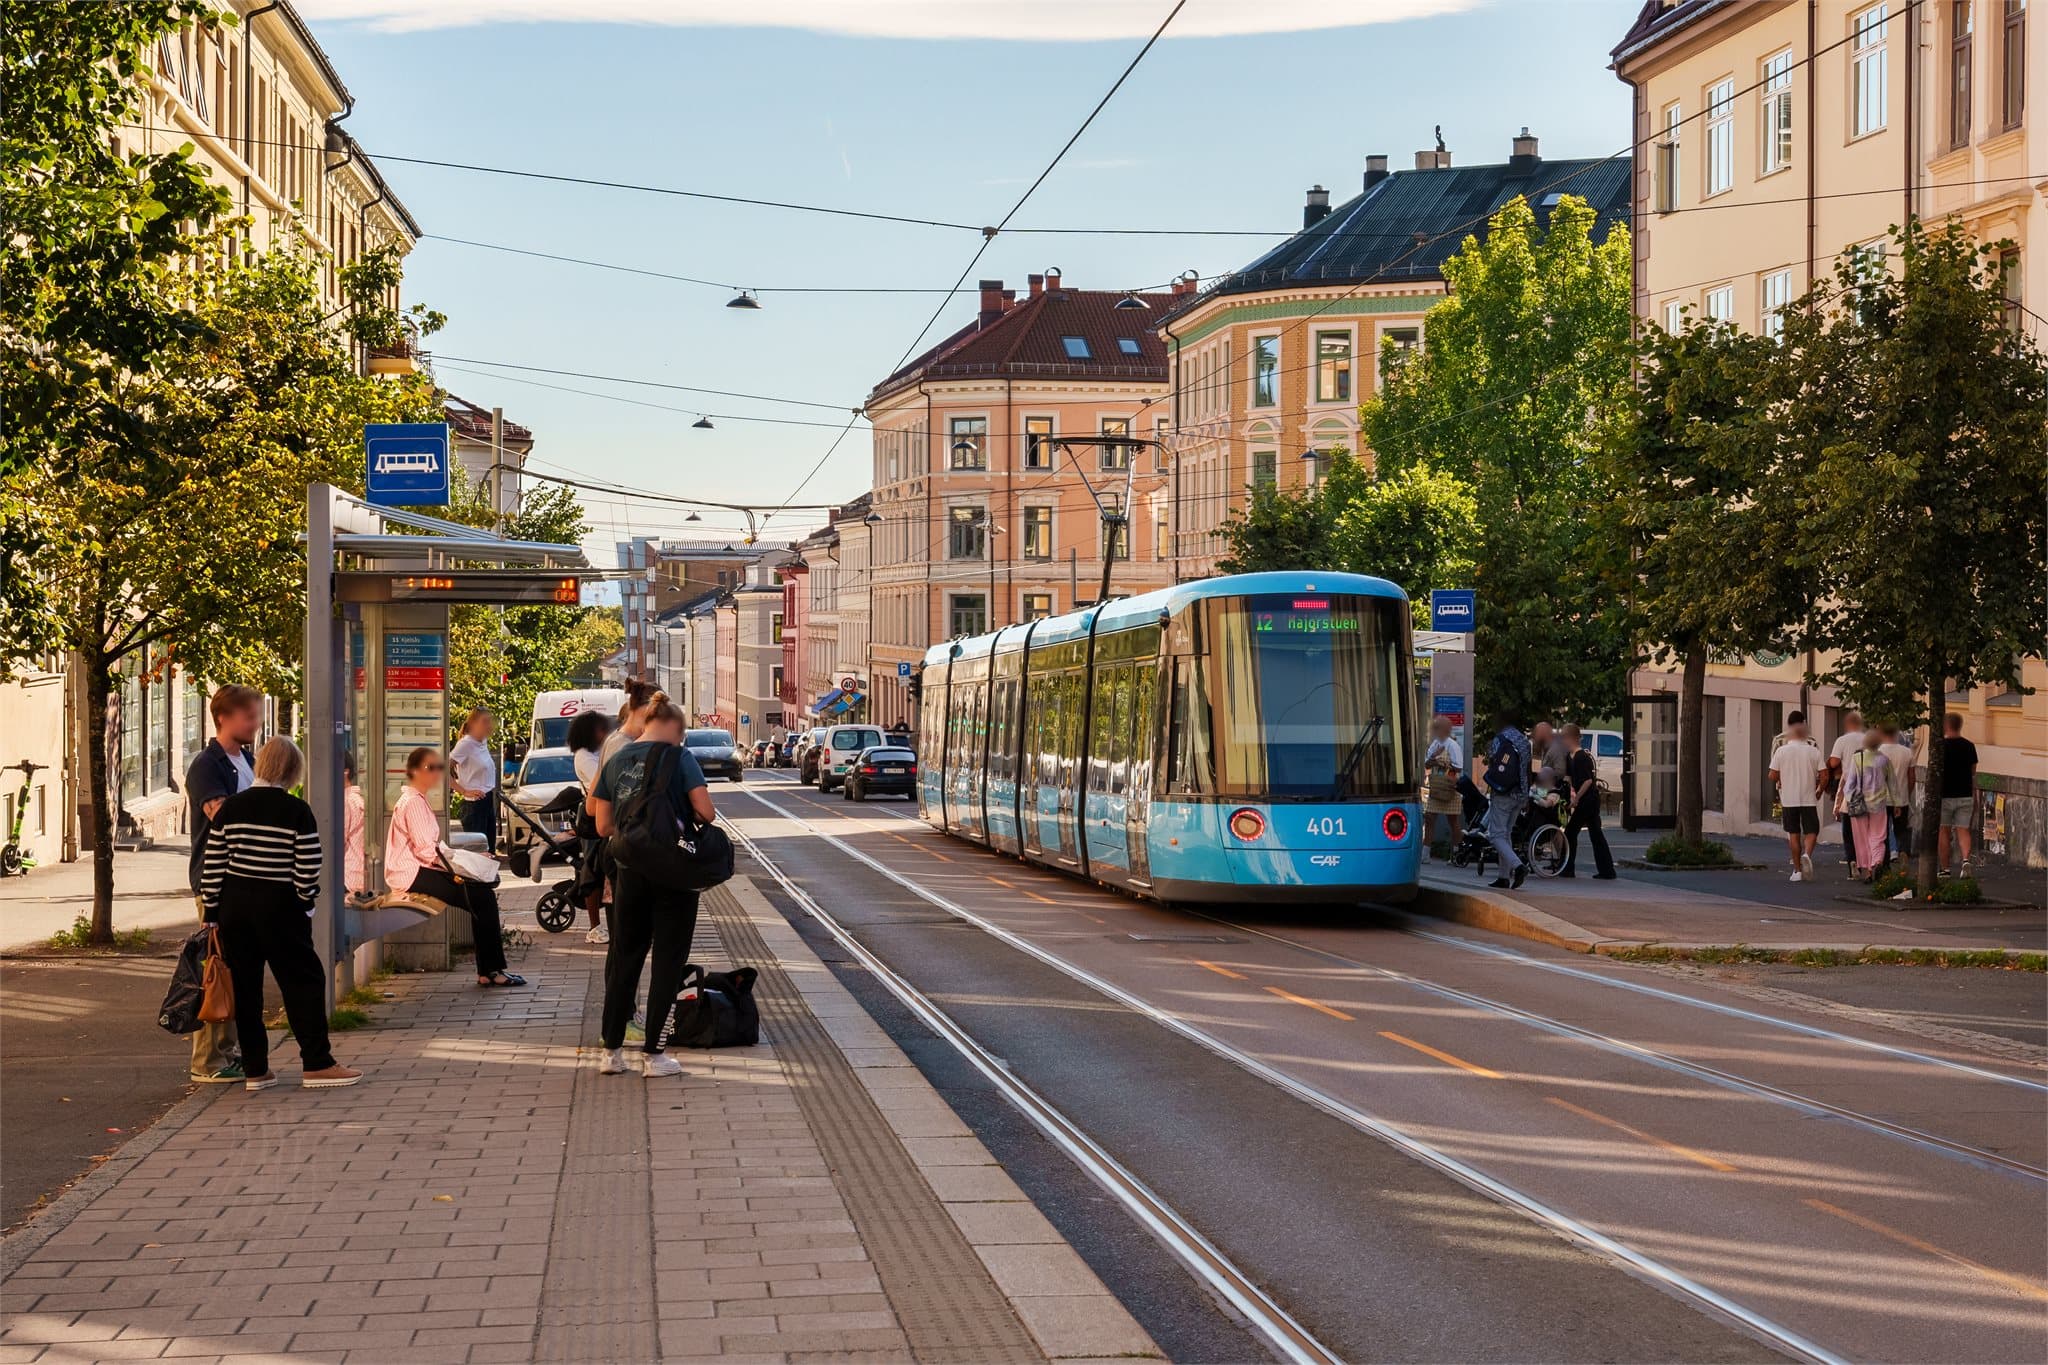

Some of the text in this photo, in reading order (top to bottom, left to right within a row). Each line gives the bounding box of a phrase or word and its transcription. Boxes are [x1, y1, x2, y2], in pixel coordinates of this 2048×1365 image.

[1256, 614, 1273, 631] 12
[900, 664, 908, 674] P
[843, 680, 854, 690] 40
[1306, 817, 1347, 836] 401
[1310, 855, 1341, 867] CAF
